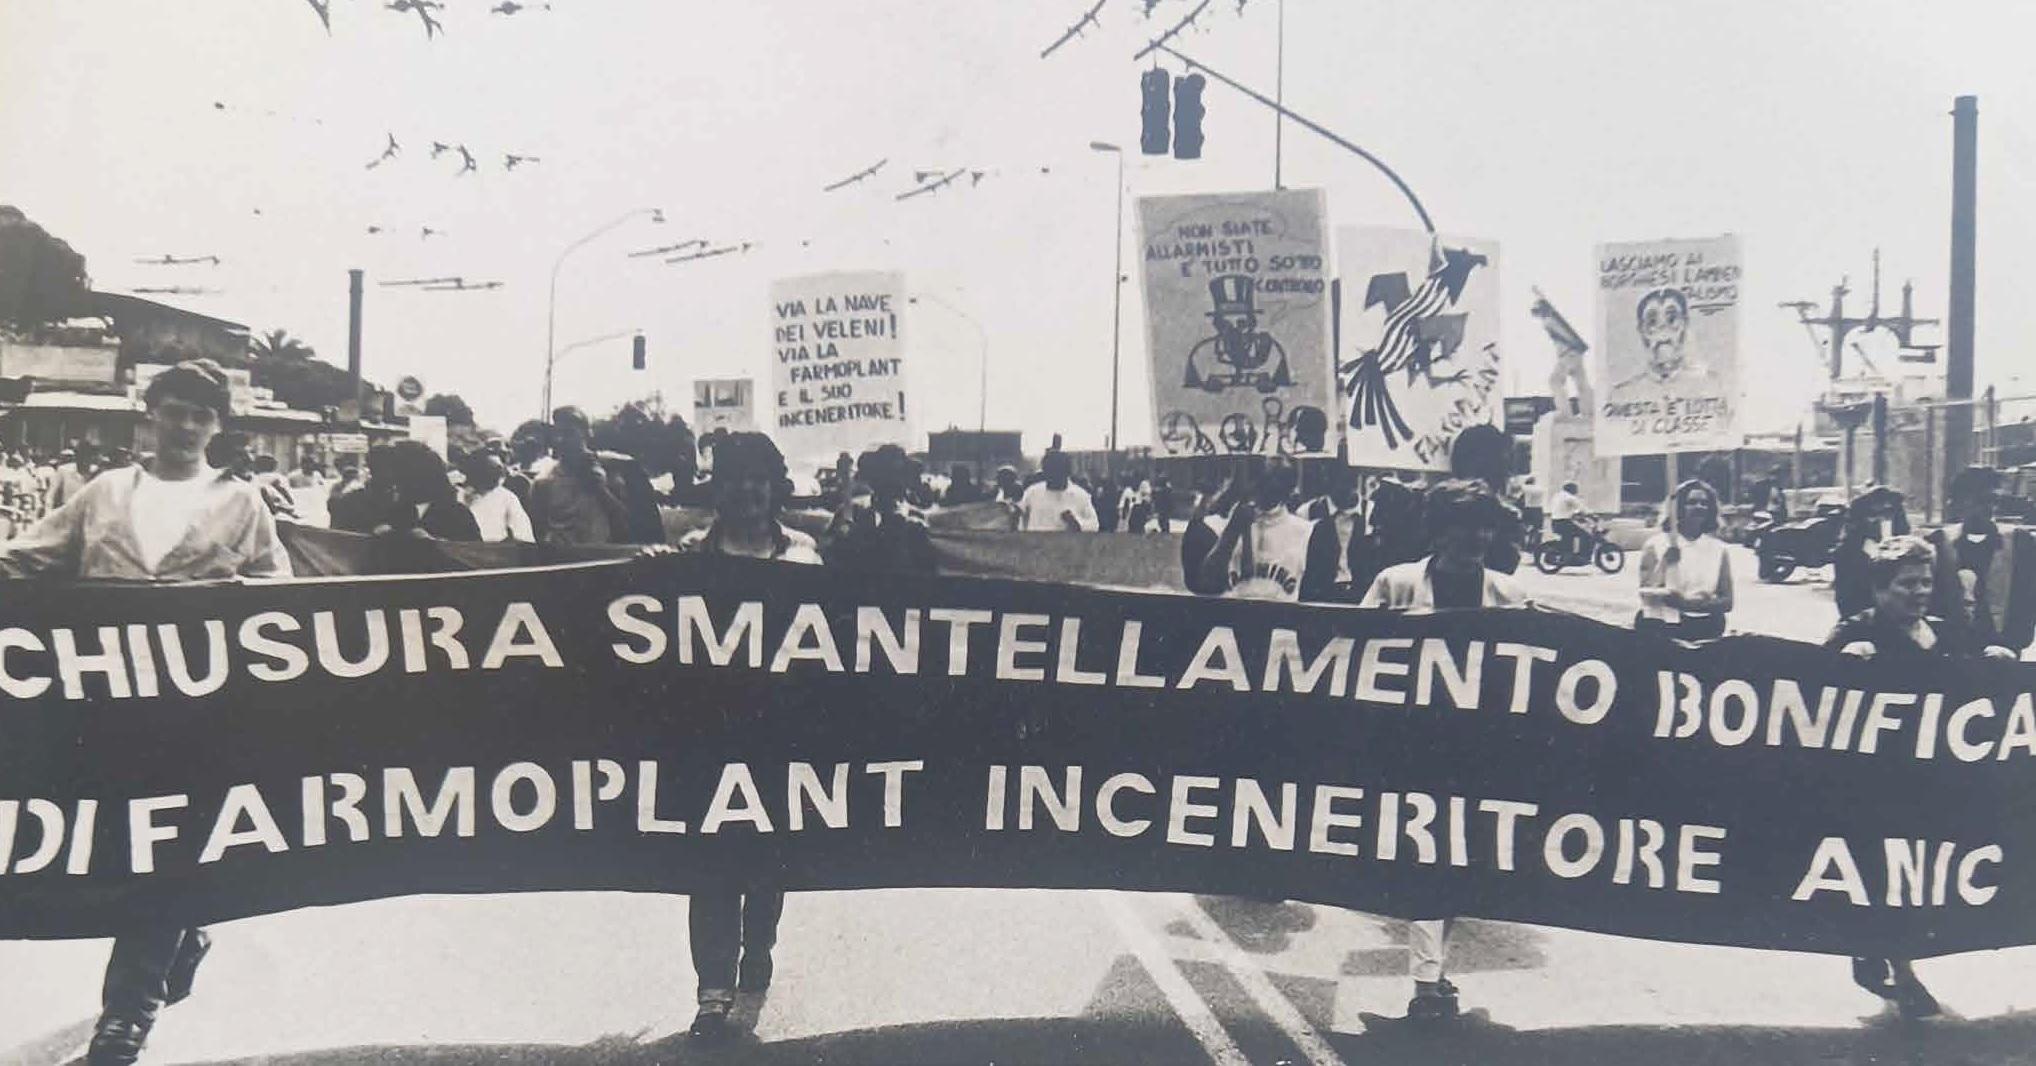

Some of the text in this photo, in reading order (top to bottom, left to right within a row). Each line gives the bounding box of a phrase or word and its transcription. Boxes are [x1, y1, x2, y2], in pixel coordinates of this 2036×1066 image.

[776, 293, 893, 318] VIA LA NAVE
[775, 324, 805, 342] DEI
[778, 342, 839, 363] VIA LA
[790, 358, 902, 384] FARMOPLANT
[778, 383, 853, 406] E IL SUO
[0, 594, 2036, 762] CHIUSURA SMANTELLAMENTO BONIFICA
[0, 759, 2002, 907] DI FARMOPLANT INCENERITORE ANIC
